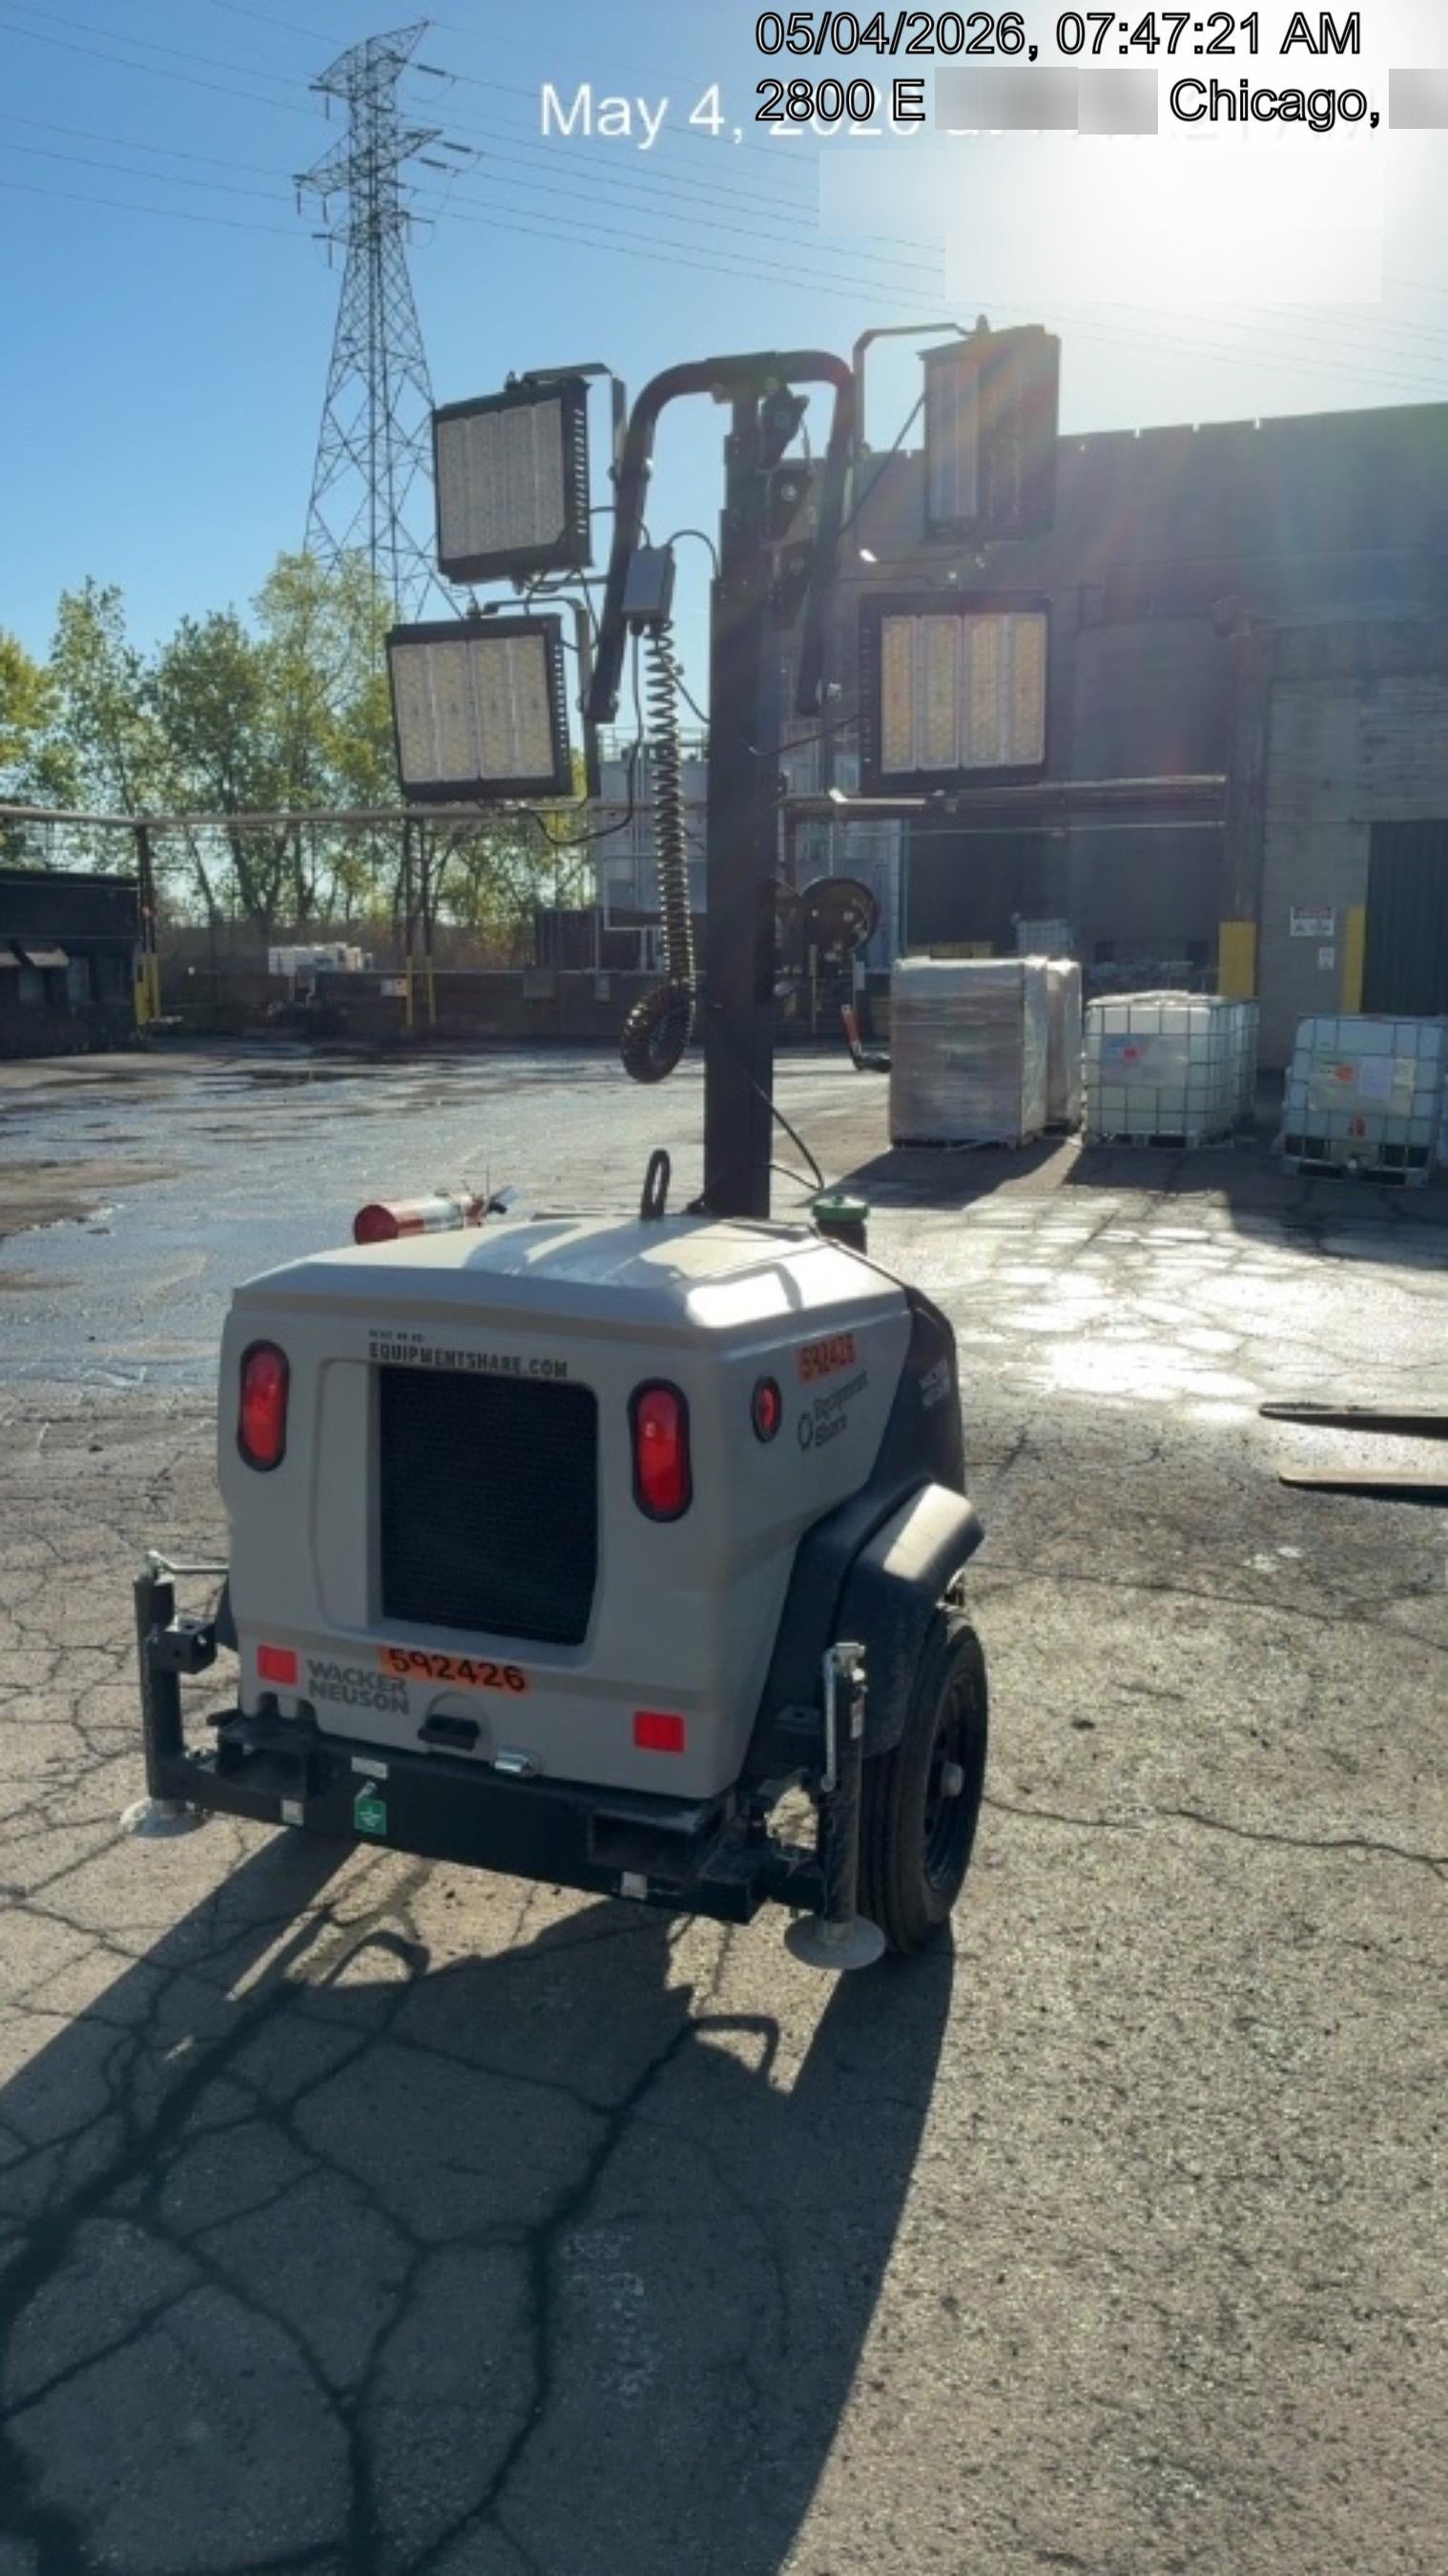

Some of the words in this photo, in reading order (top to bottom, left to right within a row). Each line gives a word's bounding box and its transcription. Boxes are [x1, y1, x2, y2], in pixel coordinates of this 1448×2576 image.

[369, 1342, 568, 1378] EQUIPMENTSHARE.COM
[306, 1659, 407, 1695] WACKER
[387, 1648, 526, 1692] 592426
[308, 1677, 410, 1714] NEUSON
